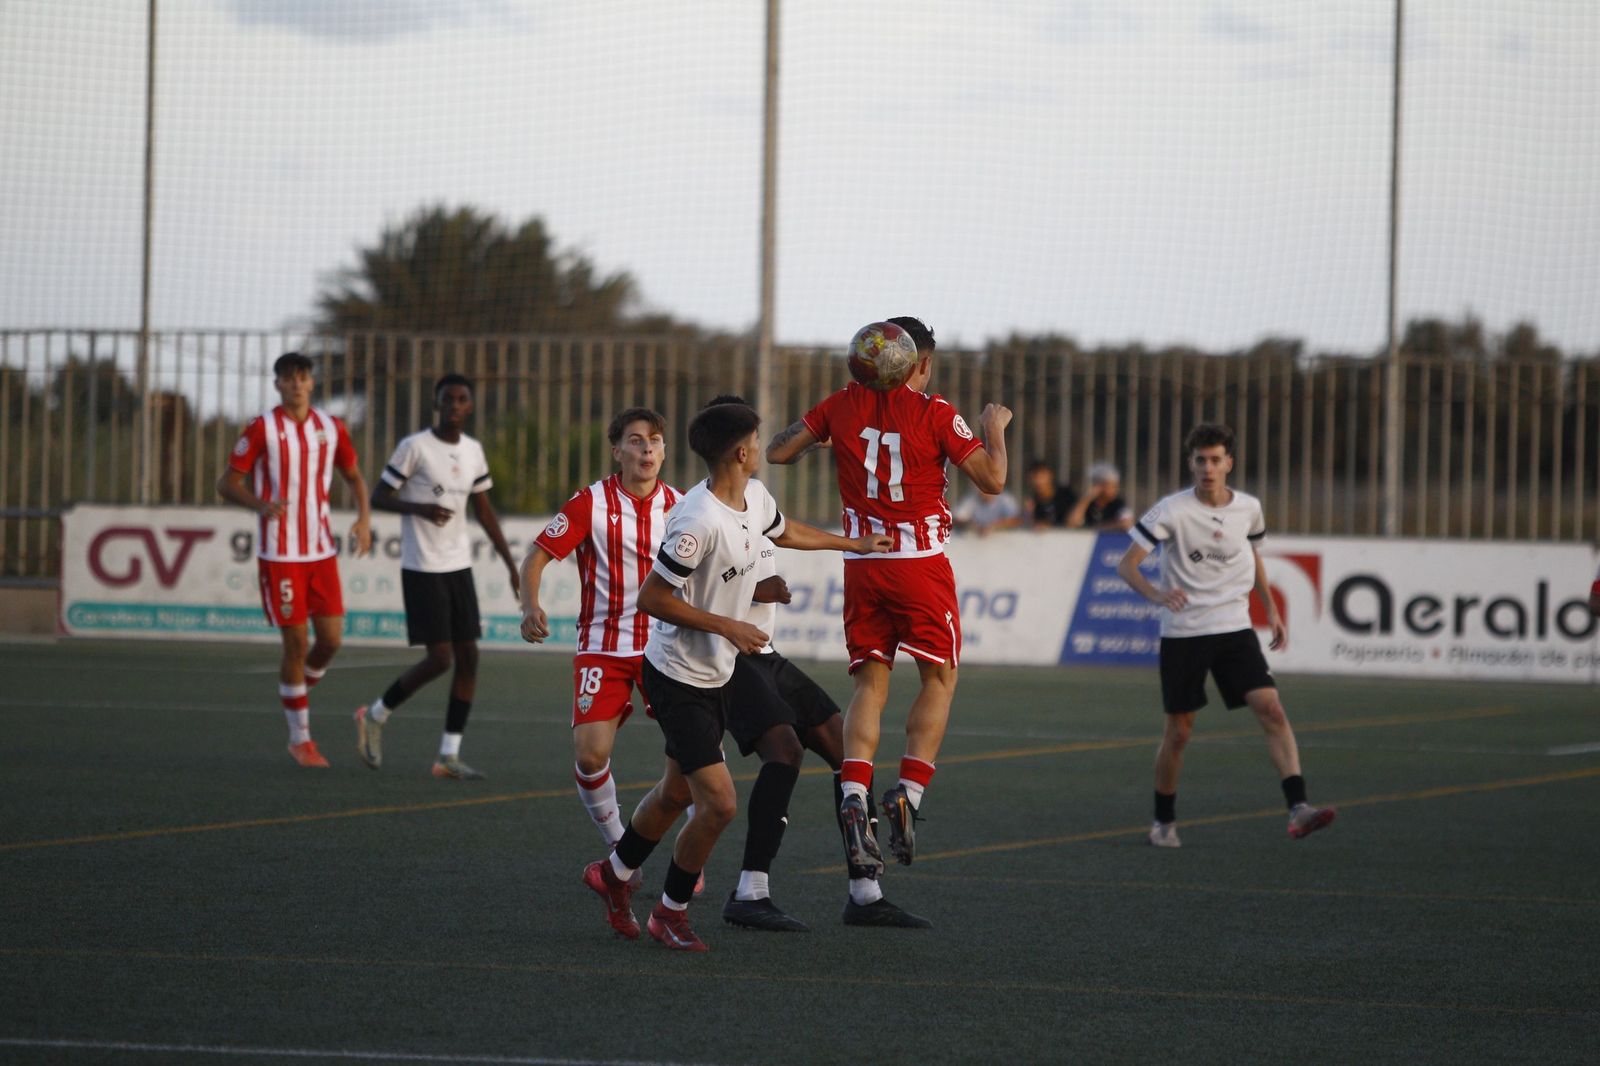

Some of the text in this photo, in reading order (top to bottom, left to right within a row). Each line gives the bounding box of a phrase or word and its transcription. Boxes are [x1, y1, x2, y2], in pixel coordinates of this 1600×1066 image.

[859, 426, 905, 503] 11
[280, 579, 293, 603] 5
[579, 667, 603, 695] 18
